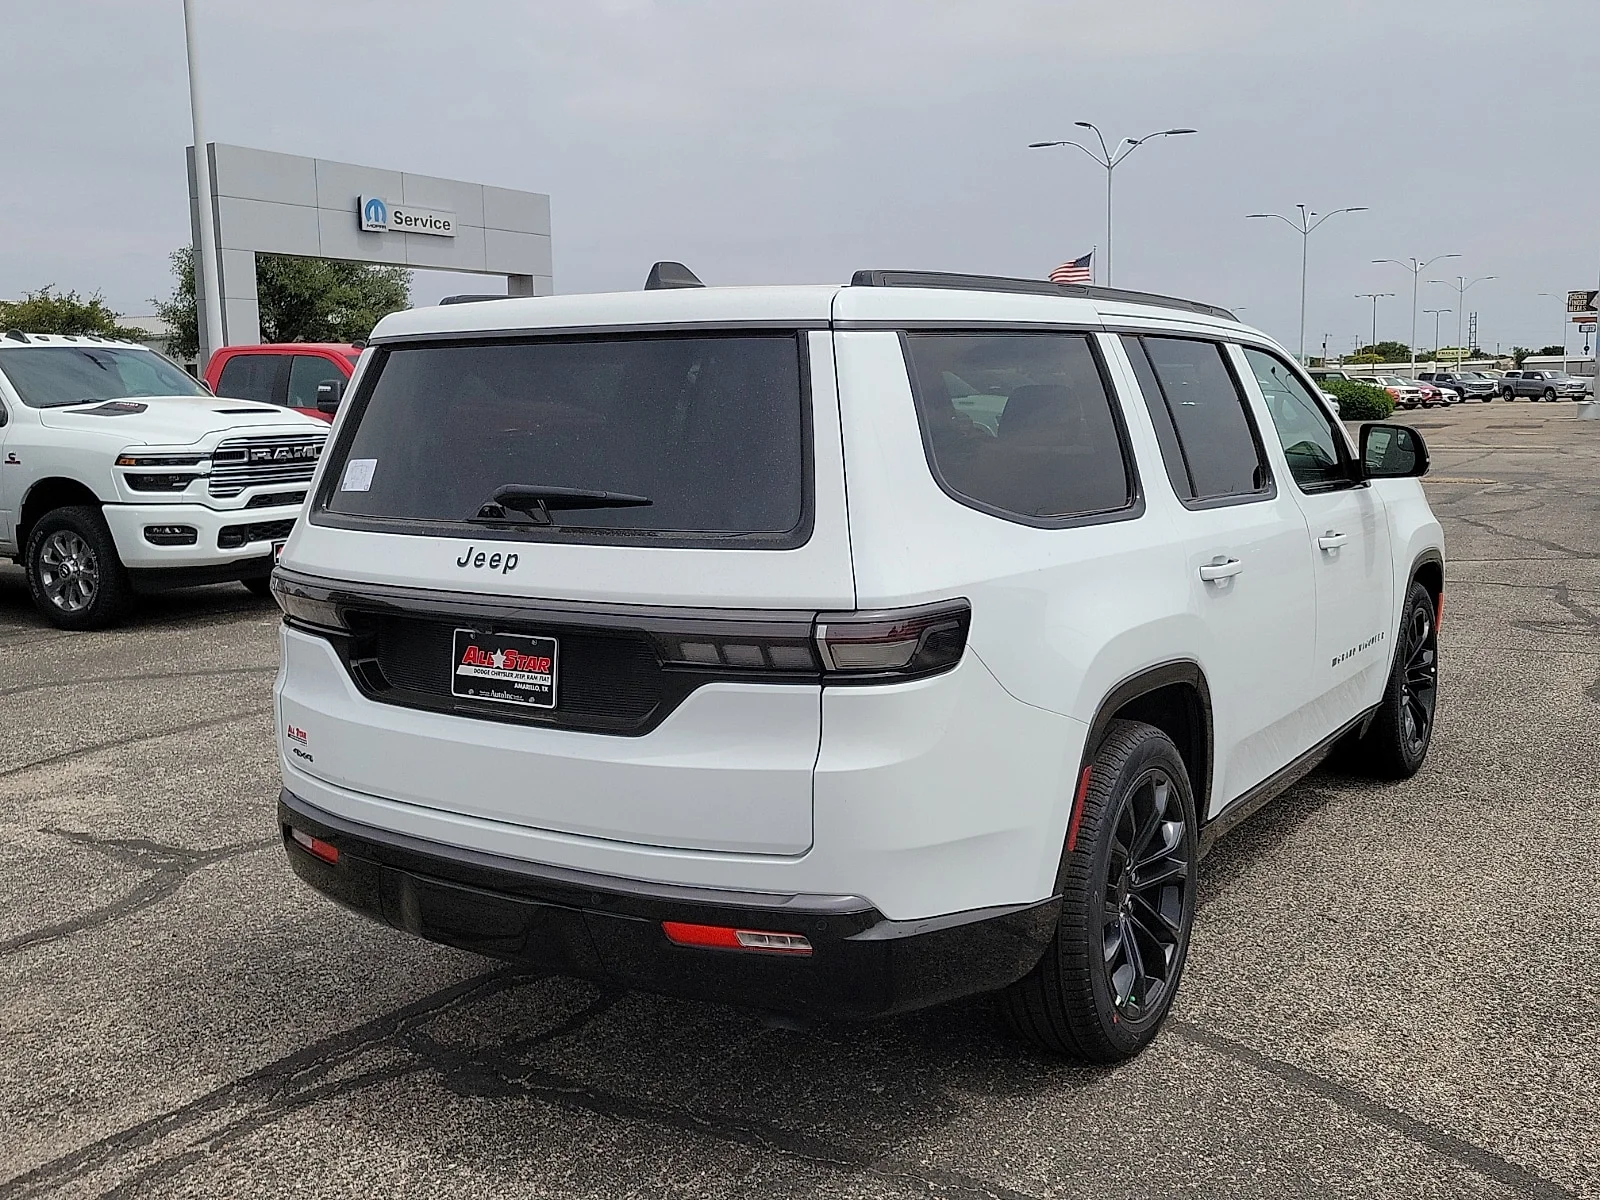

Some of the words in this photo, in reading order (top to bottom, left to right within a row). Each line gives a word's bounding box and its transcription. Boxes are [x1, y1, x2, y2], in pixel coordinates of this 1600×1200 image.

[393, 210, 451, 231] Service
[251, 446, 313, 460] RAM
[456, 546, 519, 574] Jeep
[502, 649, 551, 673] STAR
